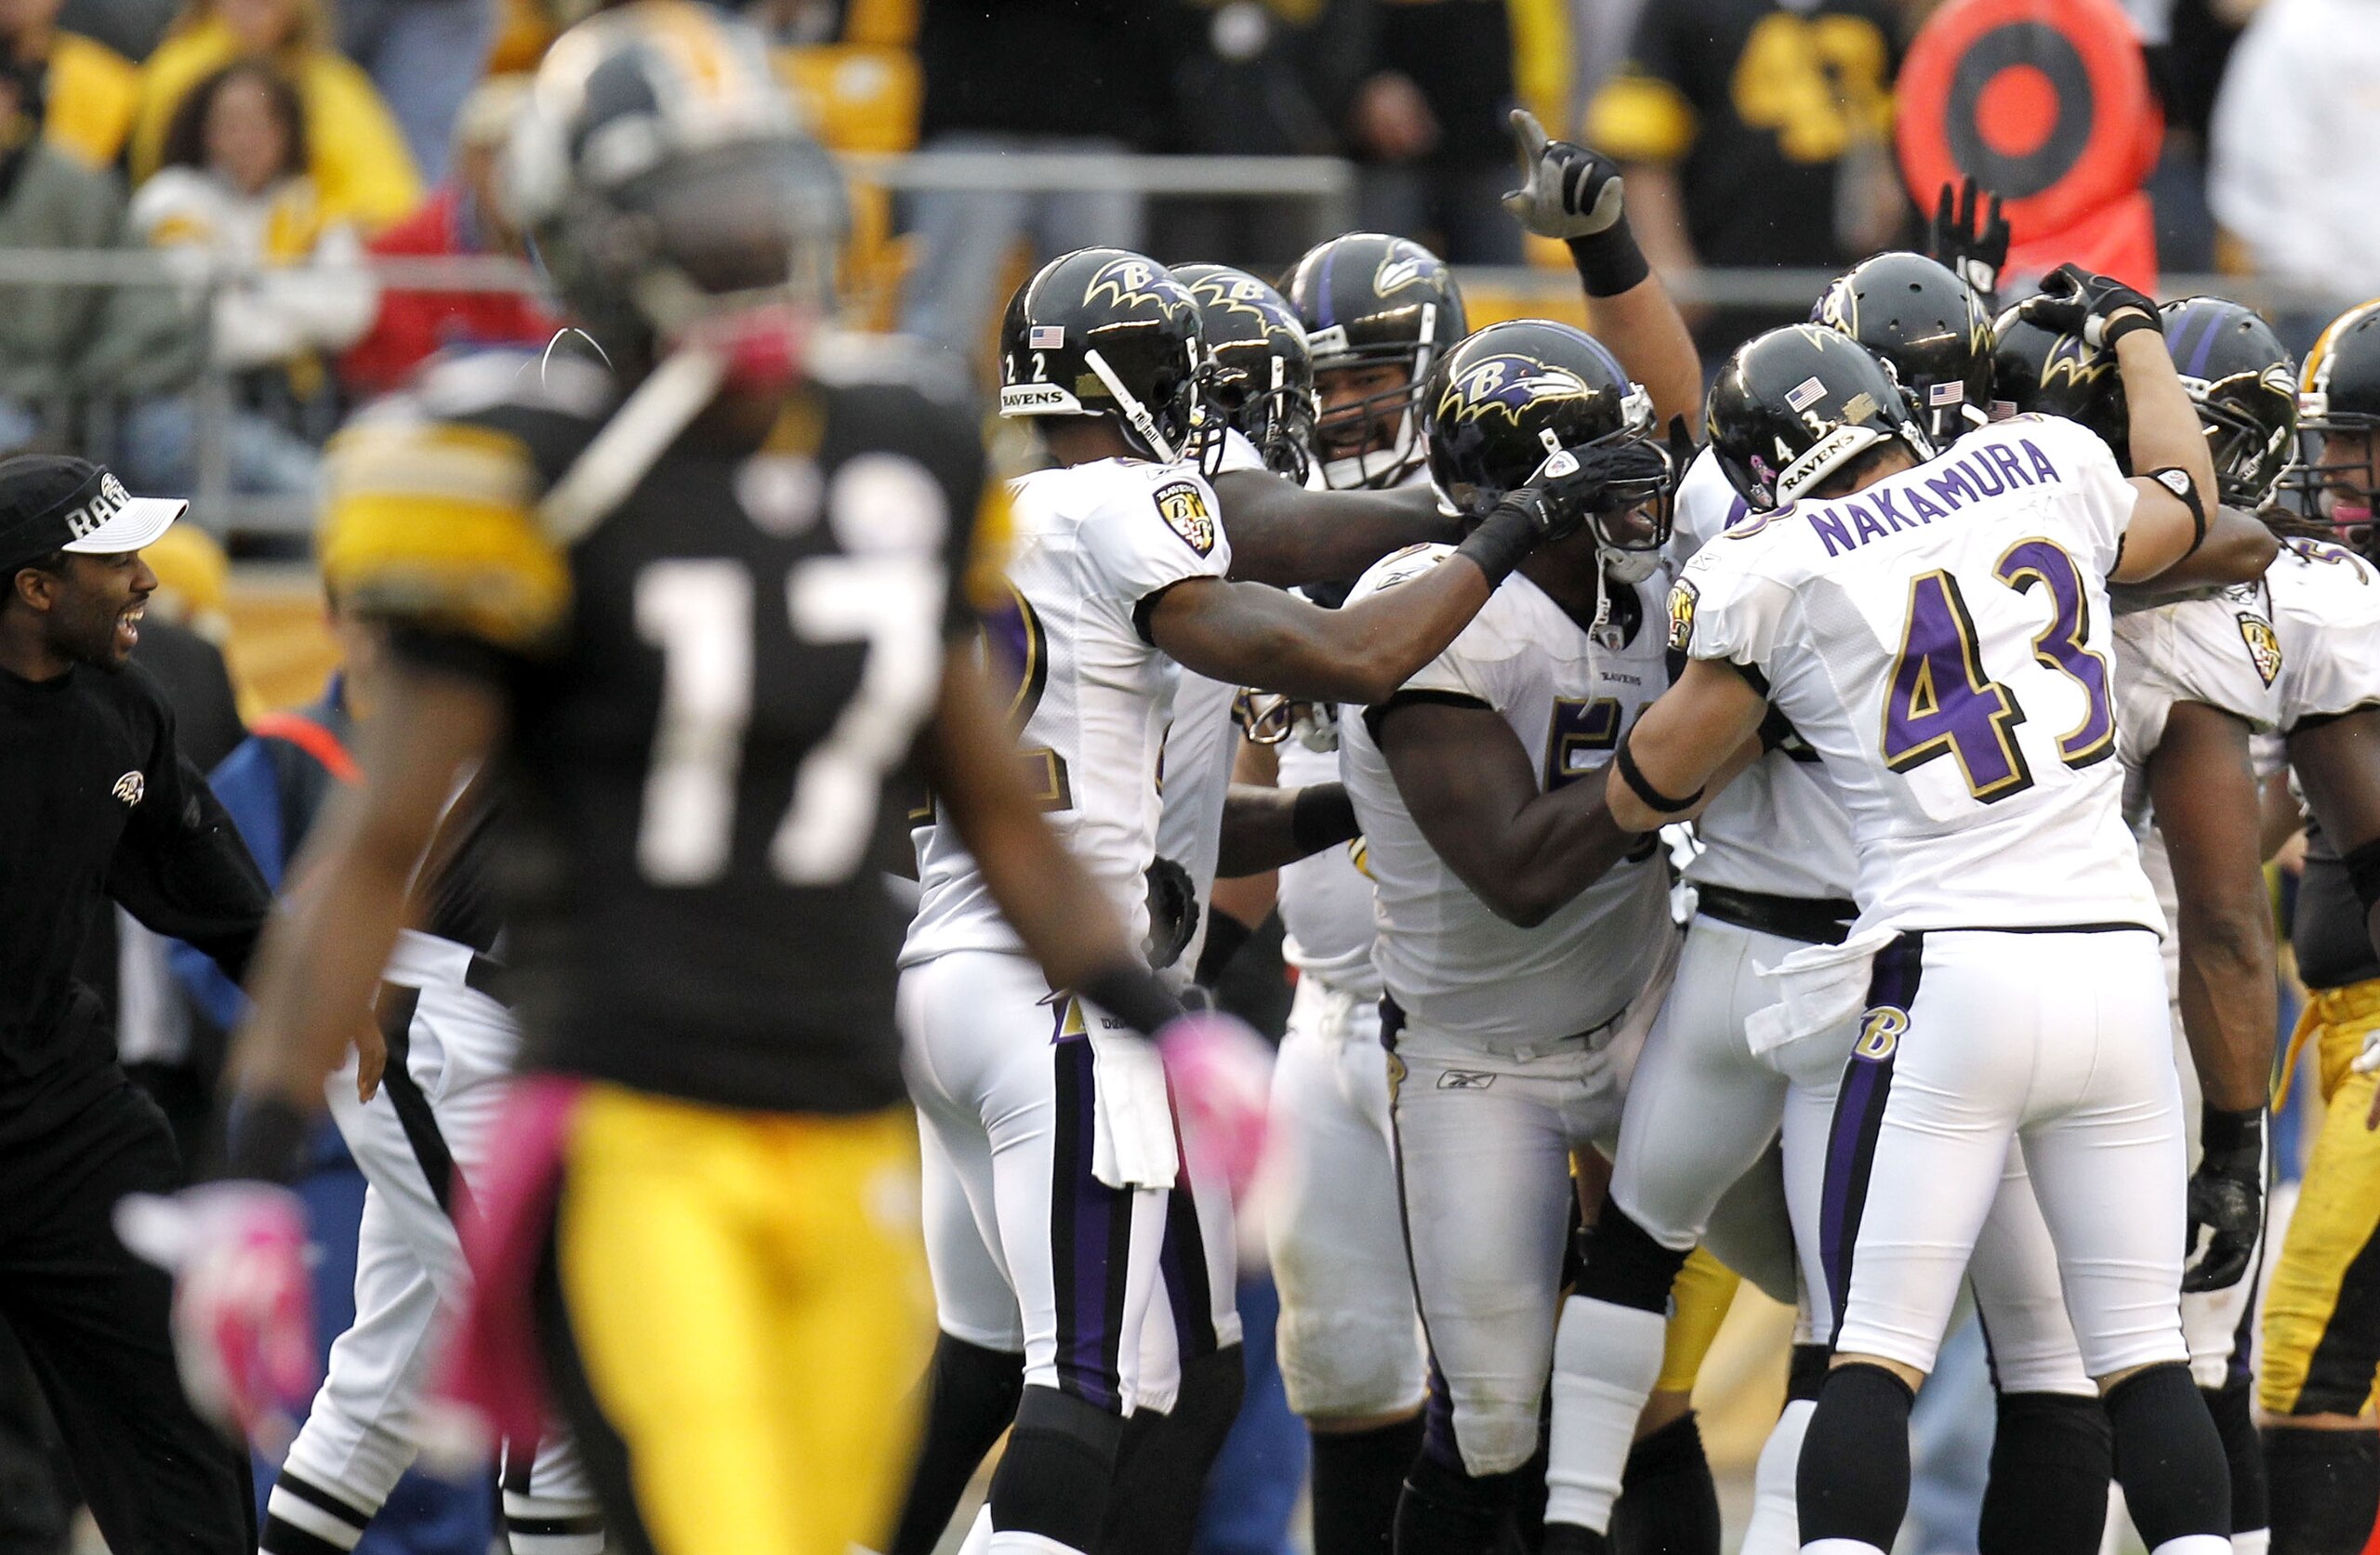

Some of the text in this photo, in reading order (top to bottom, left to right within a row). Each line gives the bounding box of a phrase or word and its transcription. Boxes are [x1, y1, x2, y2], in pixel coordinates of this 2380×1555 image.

[1002, 391, 1064, 407] RAVENS
[1781, 432, 1856, 492] RAVENS
[1806, 438, 2061, 558] NAKAMURA
[1879, 534, 2117, 805] 43
[634, 558, 946, 885] 17
[1854, 1005, 1910, 1060] B
